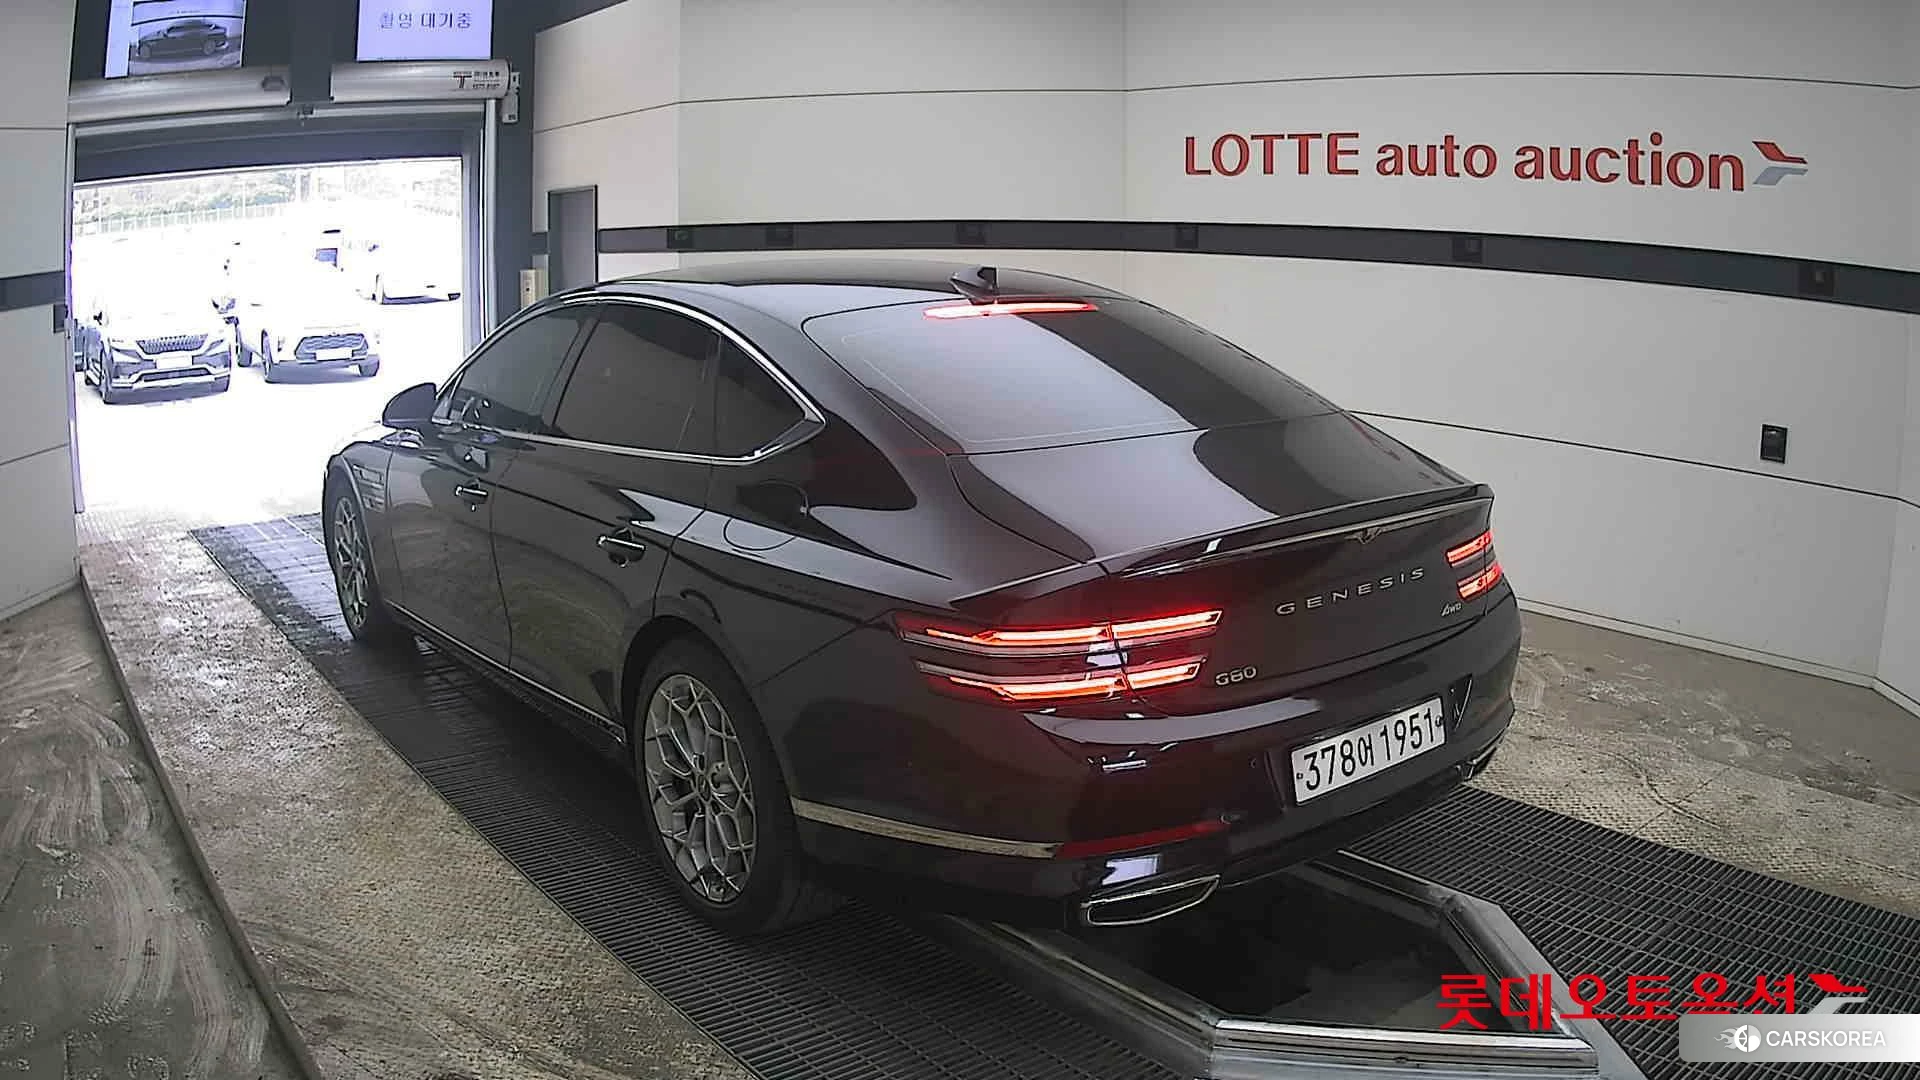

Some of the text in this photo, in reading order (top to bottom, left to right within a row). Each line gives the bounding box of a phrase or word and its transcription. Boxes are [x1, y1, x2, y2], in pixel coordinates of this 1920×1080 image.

[421, 11, 472, 29] 대기중
[1184, 131, 1745, 192] LOTTE auto auction
[1276, 567, 1425, 615] GENESIS
[1215, 665, 1257, 686] G80
[1303, 707, 1434, 791] 378어 1951
